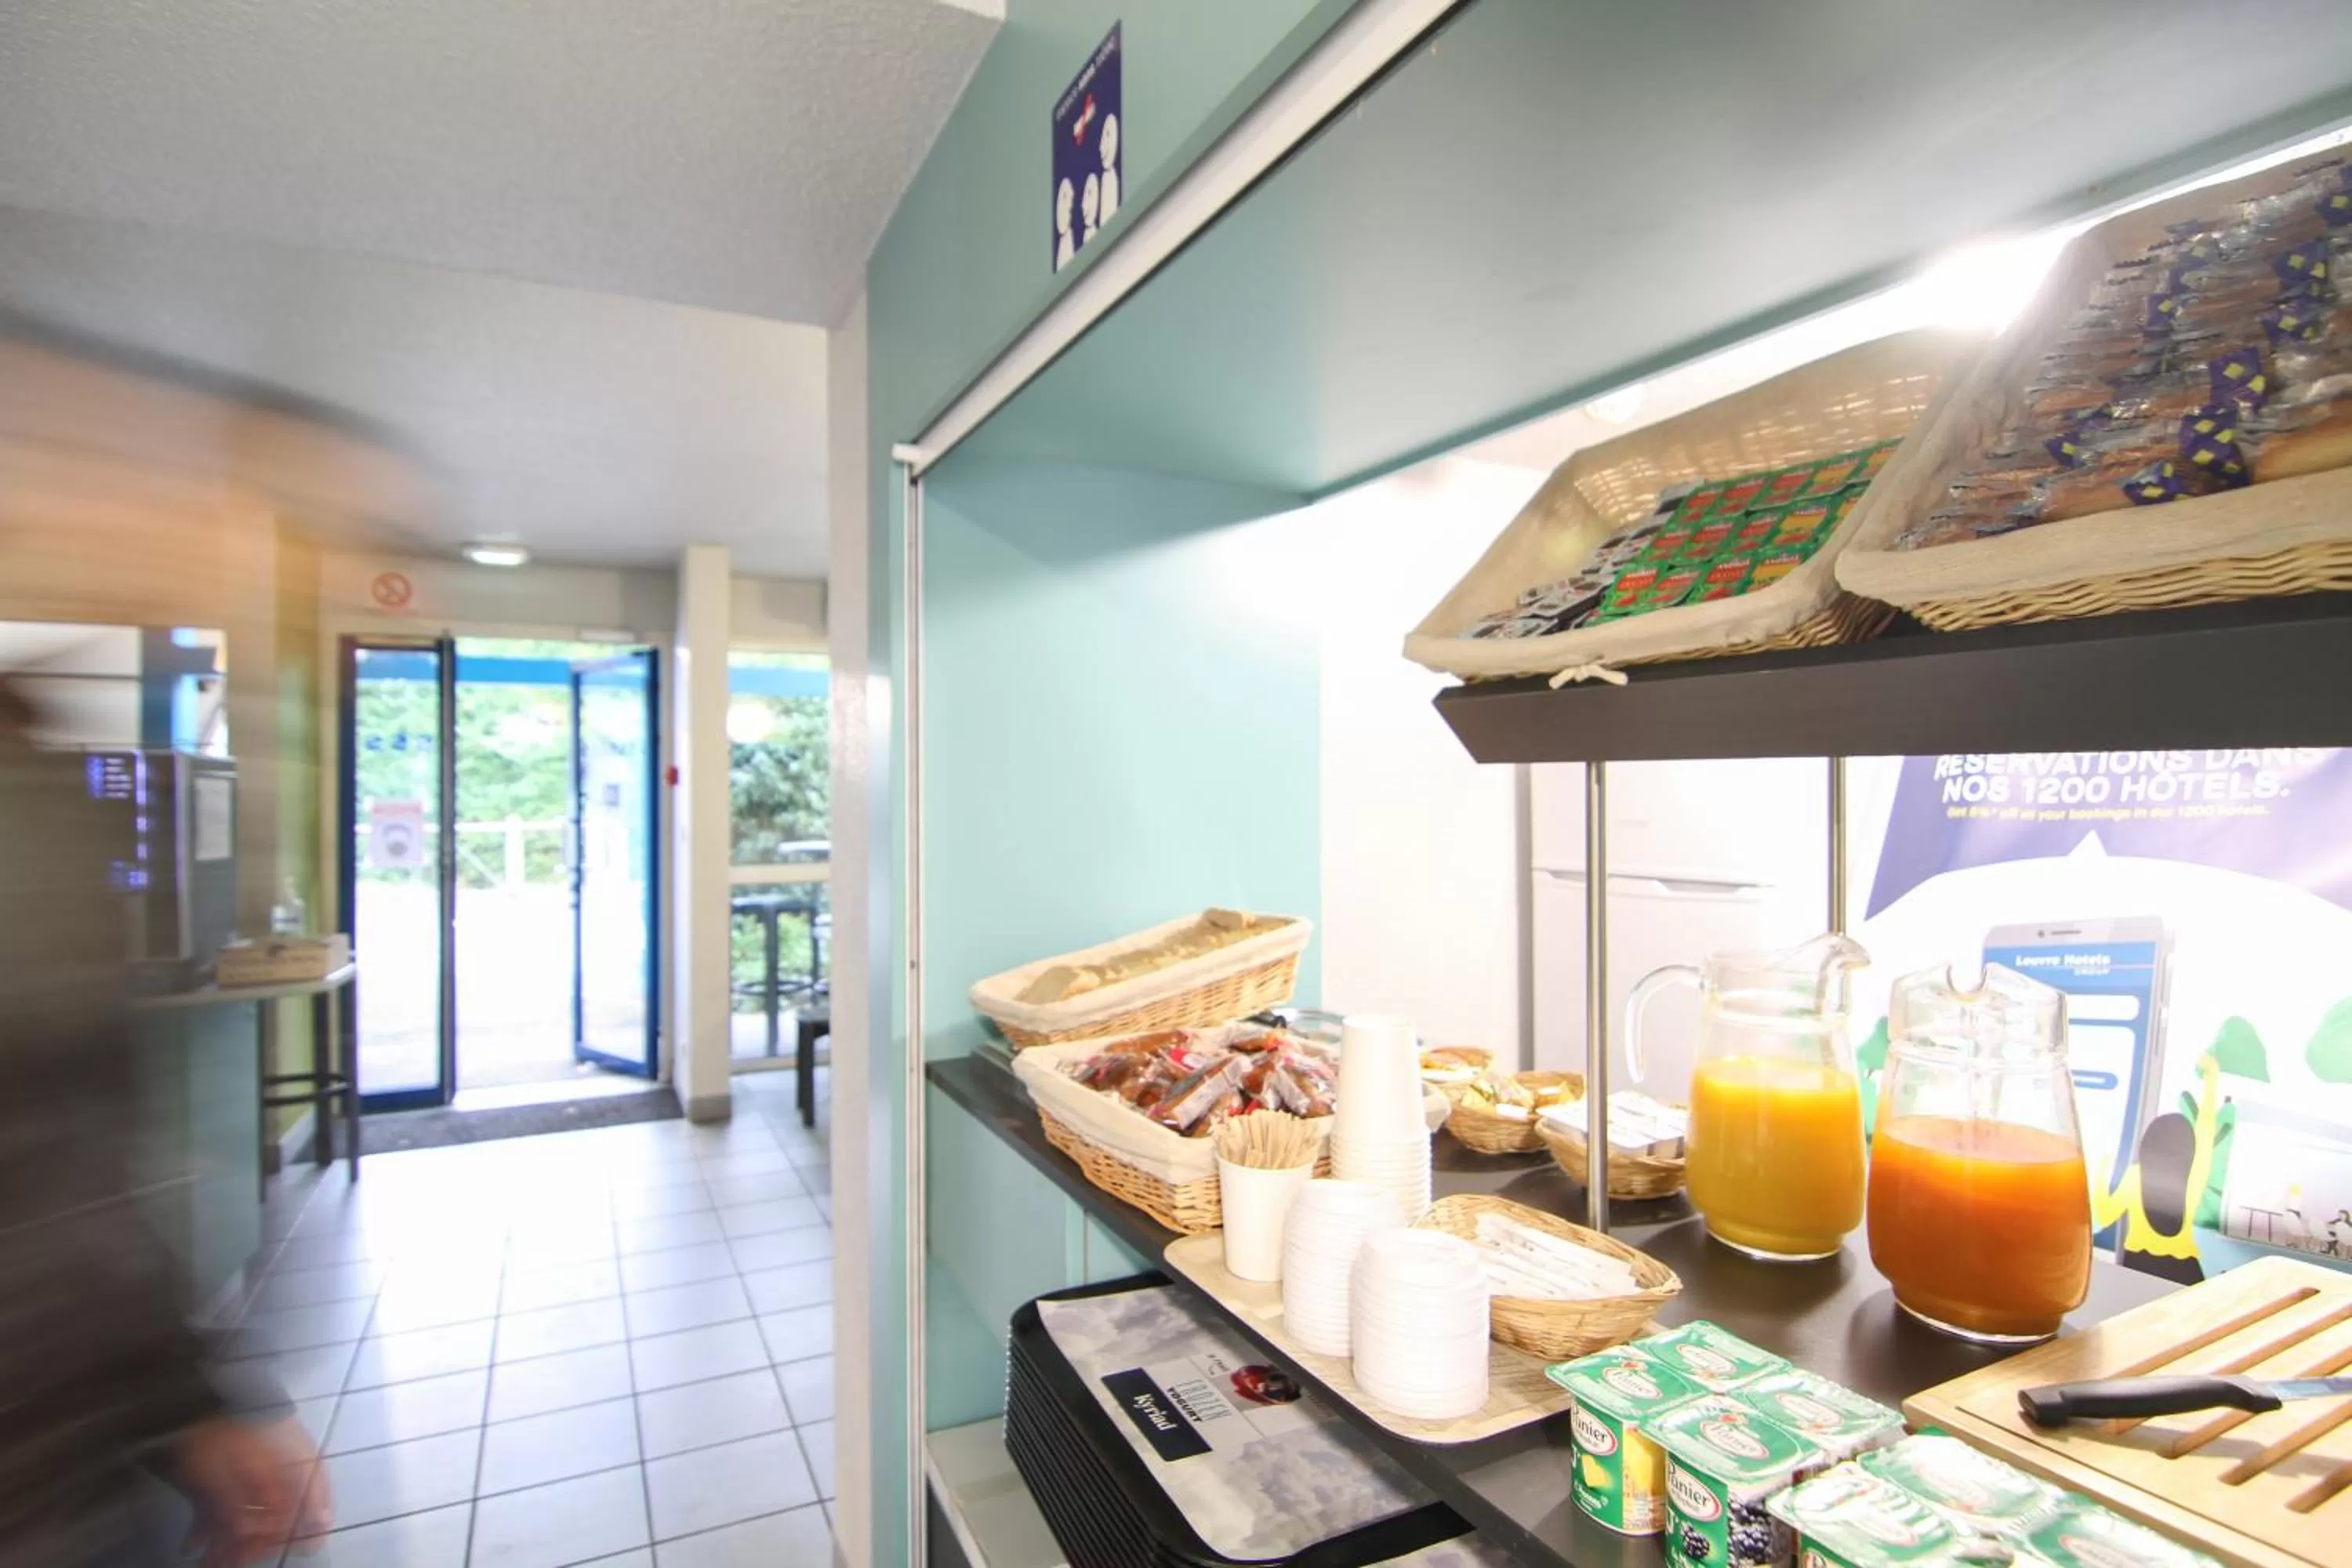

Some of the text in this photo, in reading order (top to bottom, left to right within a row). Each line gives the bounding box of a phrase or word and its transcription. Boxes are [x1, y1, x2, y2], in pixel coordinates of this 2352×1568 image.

[1943, 774, 2012, 804] NOS
[2022, 775, 2111, 804] 1200
[2015, 953, 2111, 967] Louvre Hotels
[1132, 1392, 1178, 1432] Kyriad
[1167, 1386, 1203, 1423] YOGURT
[1668, 1461, 1710, 1506] Panier
